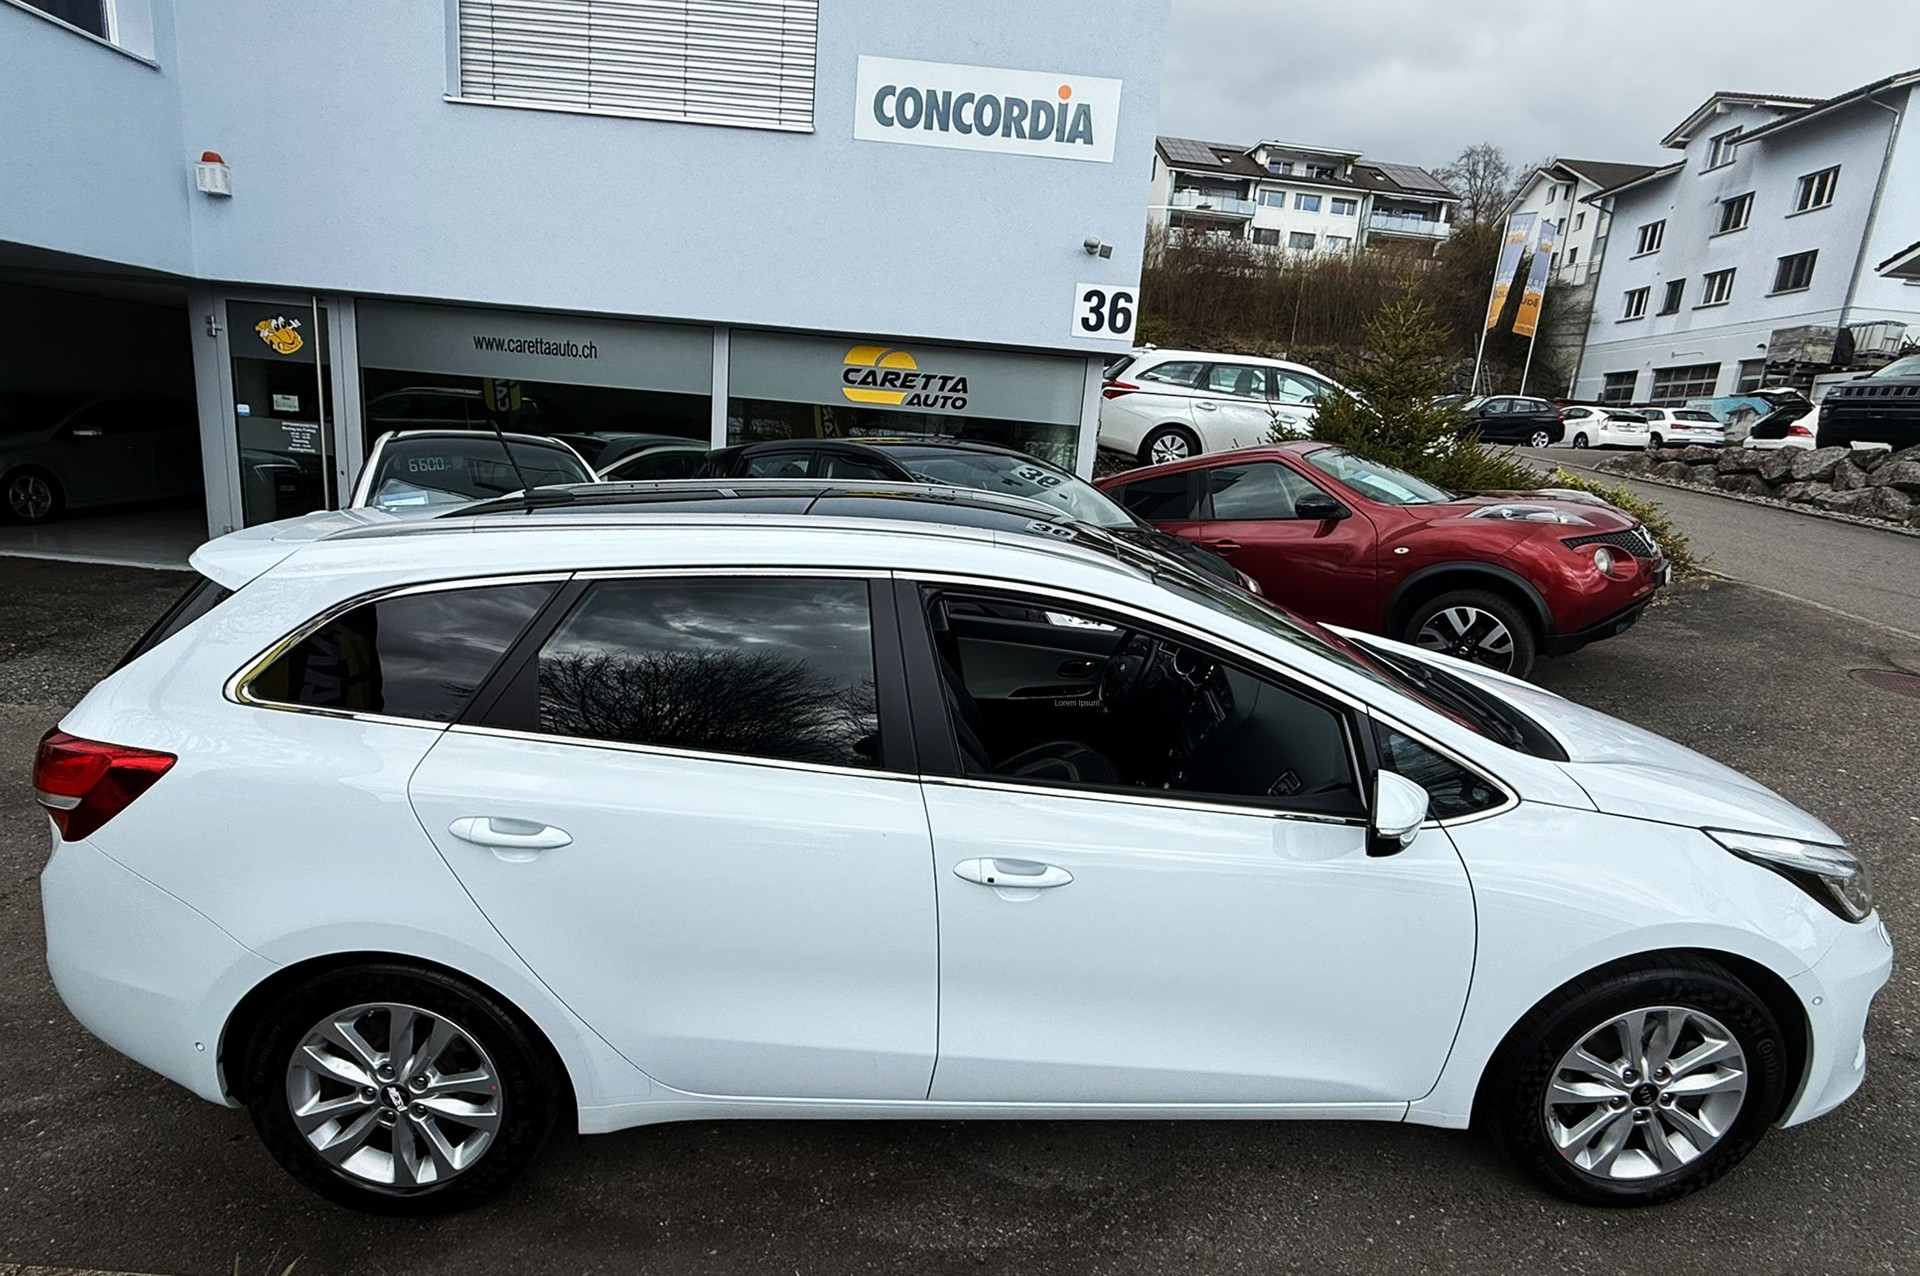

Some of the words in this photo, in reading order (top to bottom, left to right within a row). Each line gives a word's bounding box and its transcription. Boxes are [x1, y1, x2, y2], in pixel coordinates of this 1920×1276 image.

[873, 84, 1094, 146] CONCORDIA
[1081, 289, 1133, 334] 36
[473, 336, 598, 359] www.carettaauto.ch
[842, 368, 968, 394] CARETTA
[906, 393, 967, 410] AUTO
